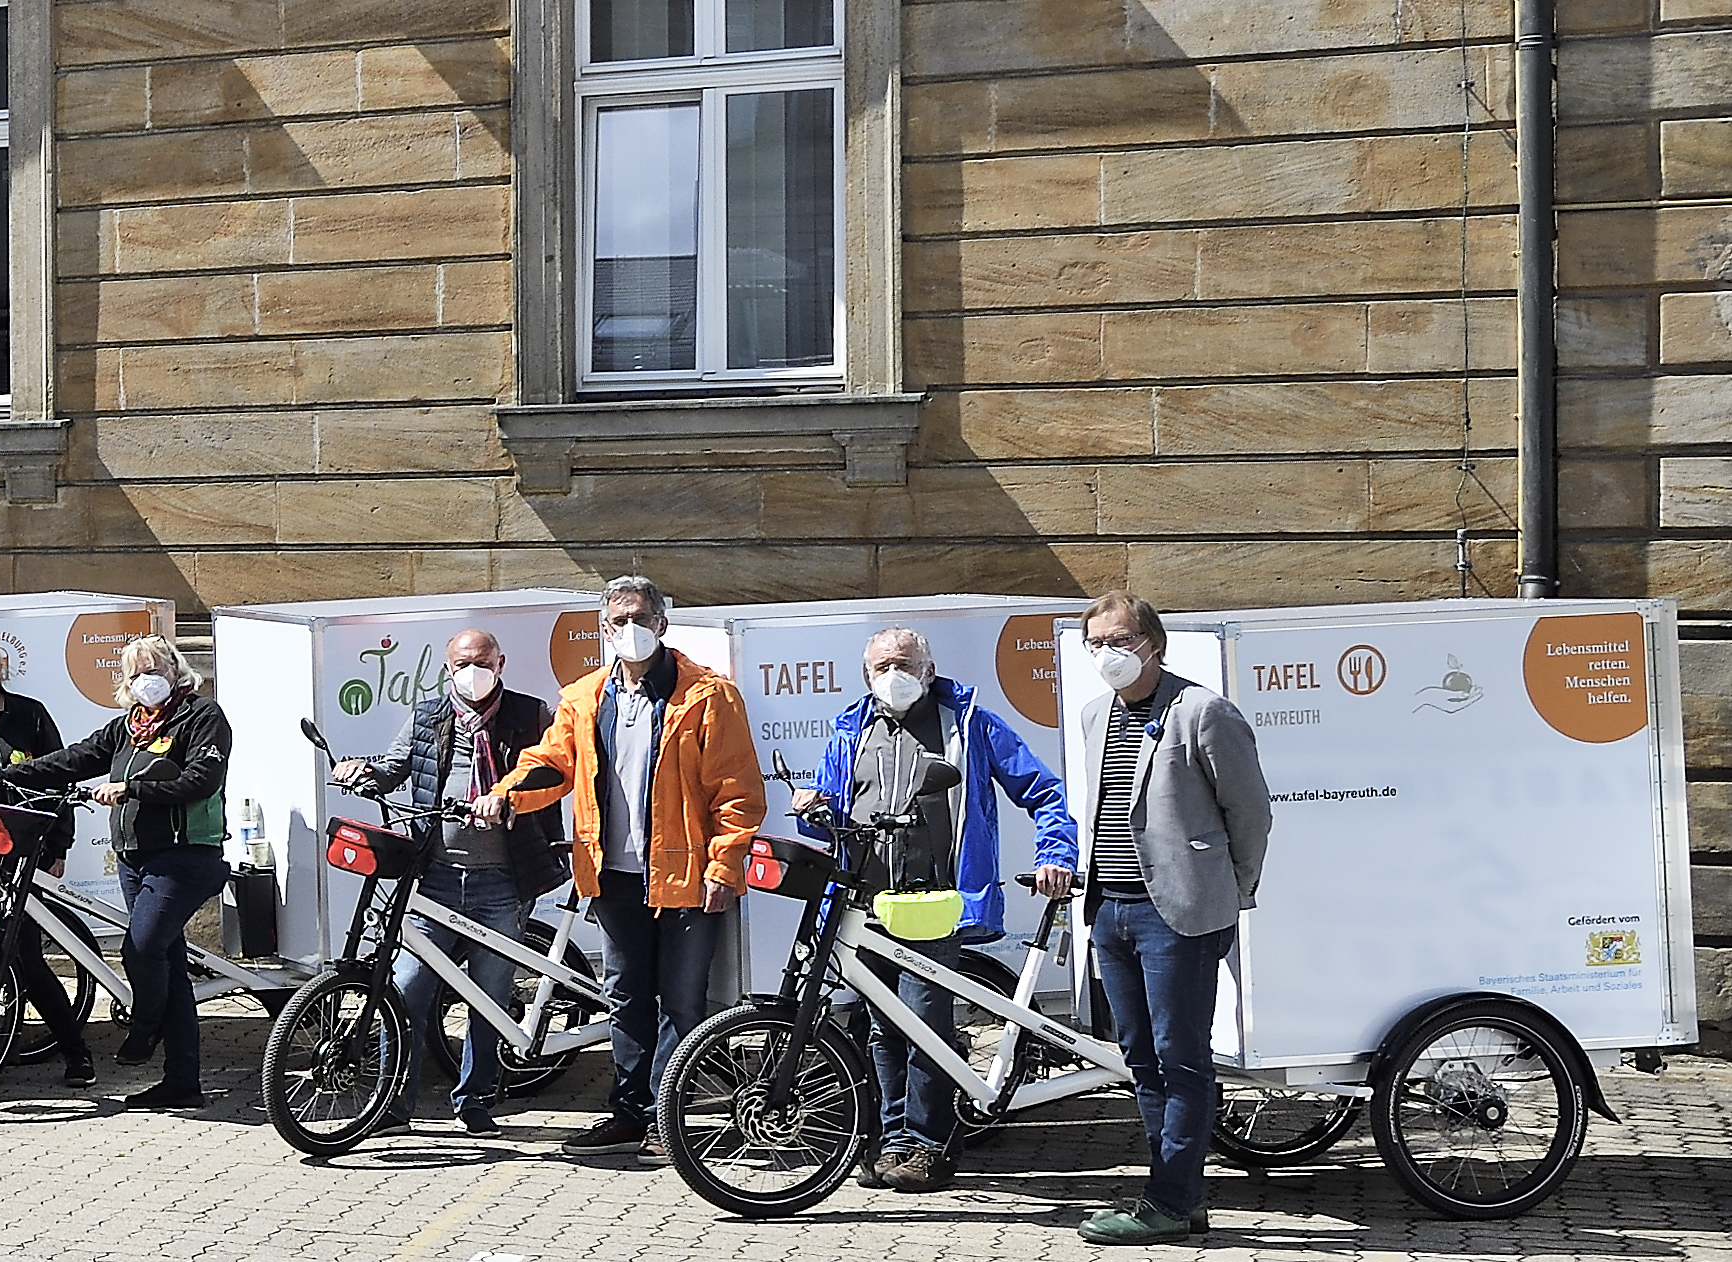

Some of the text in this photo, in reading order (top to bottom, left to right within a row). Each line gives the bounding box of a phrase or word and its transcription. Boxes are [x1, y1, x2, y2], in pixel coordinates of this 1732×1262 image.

[1546, 640, 1629, 656] Lebensmittel
[1588, 659, 1630, 670] retten.
[759, 661, 842, 695] TAFEL
[1253, 663, 1321, 691] TAFEL
[1565, 675, 1631, 688] Menschen
[1587, 691, 1632, 705] helfen.
[1255, 709, 1321, 727] BAYREUTH
[1269, 786, 1397, 803] ww.tafel-bayreuth.de
[1568, 915, 1641, 926] Gefördert vom
[1479, 968, 1642, 986] Bayerisches Staatsministerium für
[1550, 984, 1580, 994] Arbeit
[1583, 982, 1601, 992] und
